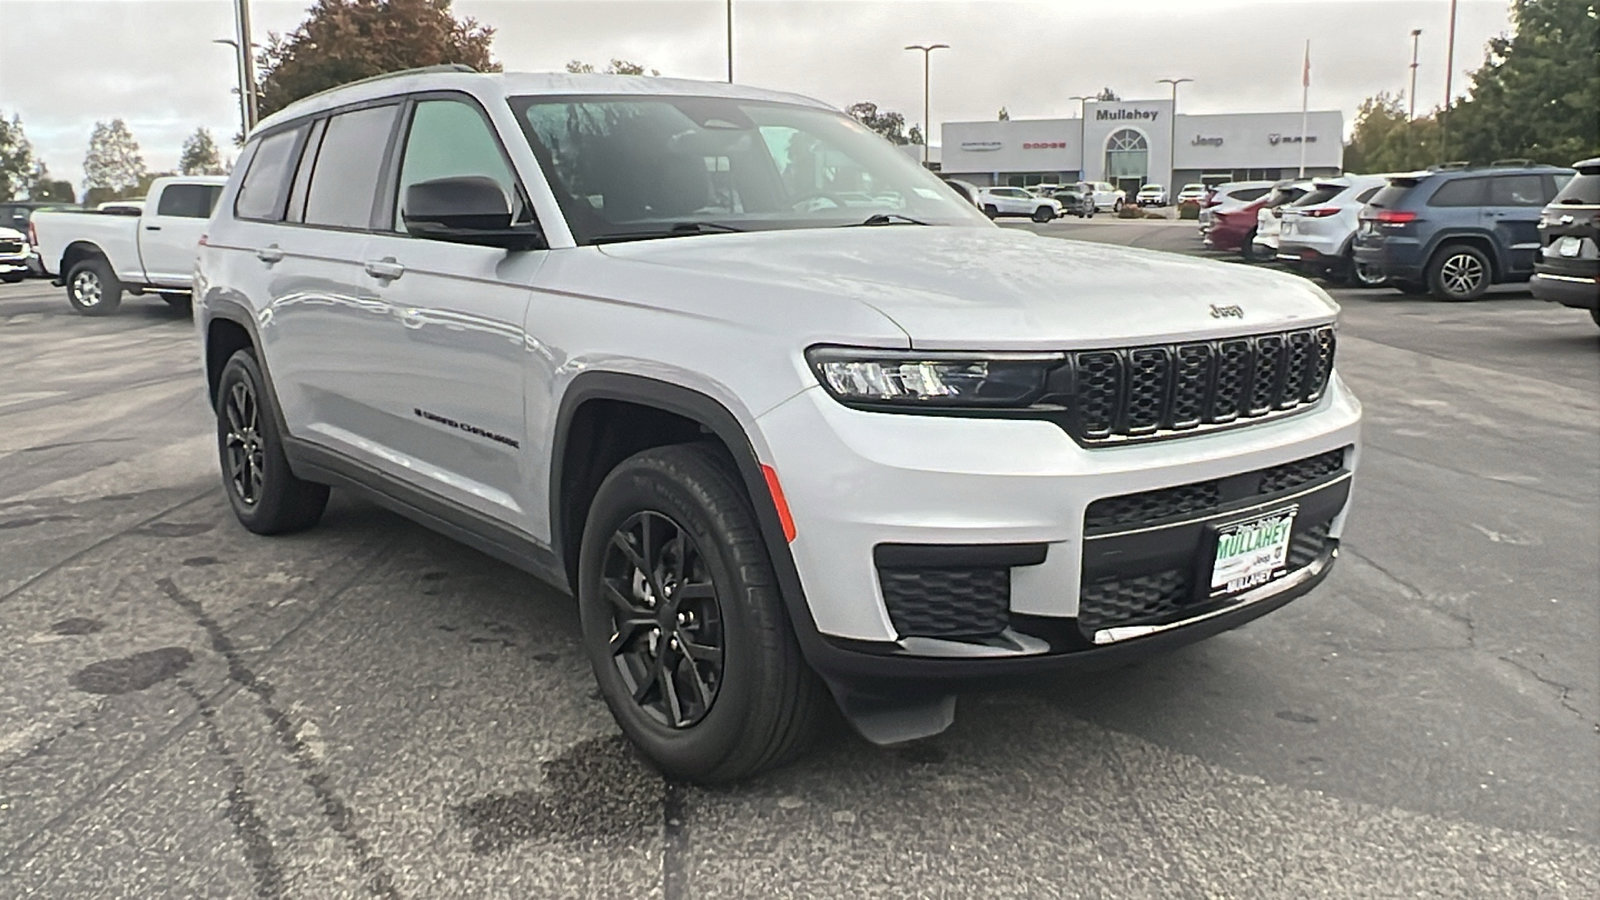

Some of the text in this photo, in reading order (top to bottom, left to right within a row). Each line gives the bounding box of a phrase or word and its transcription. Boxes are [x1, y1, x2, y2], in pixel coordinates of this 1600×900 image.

[1192, 135, 1223, 146] Jeep
[1209, 304, 1244, 320] Jeep
[1218, 522, 1289, 560] MULLAHEY
